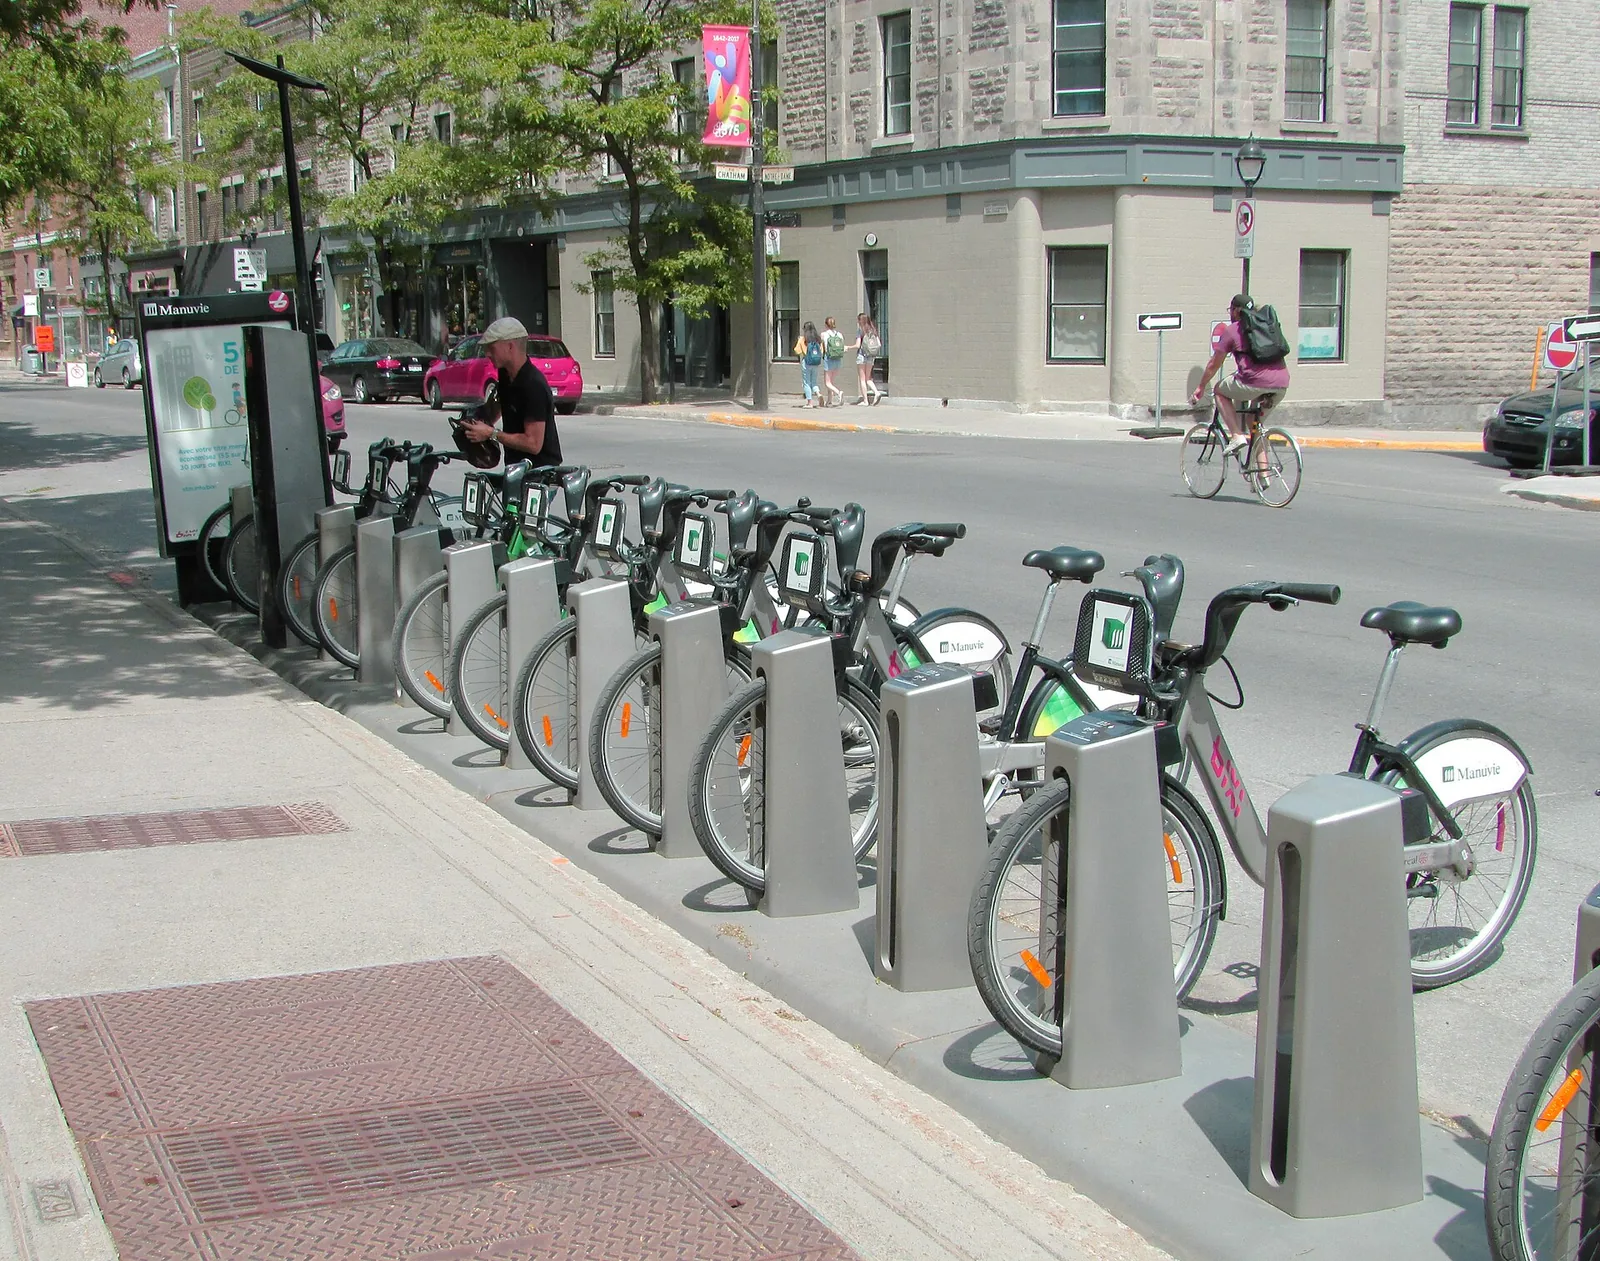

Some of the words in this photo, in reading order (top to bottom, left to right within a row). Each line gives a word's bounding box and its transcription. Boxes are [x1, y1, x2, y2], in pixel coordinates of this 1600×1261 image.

[717, 171, 746, 181] CHATHAM
[159, 303, 210, 316] Manuvie
[224, 365, 240, 375] DE
[950, 640, 985, 652] Manuvie
[1457, 763, 1501, 781] Manuvie
